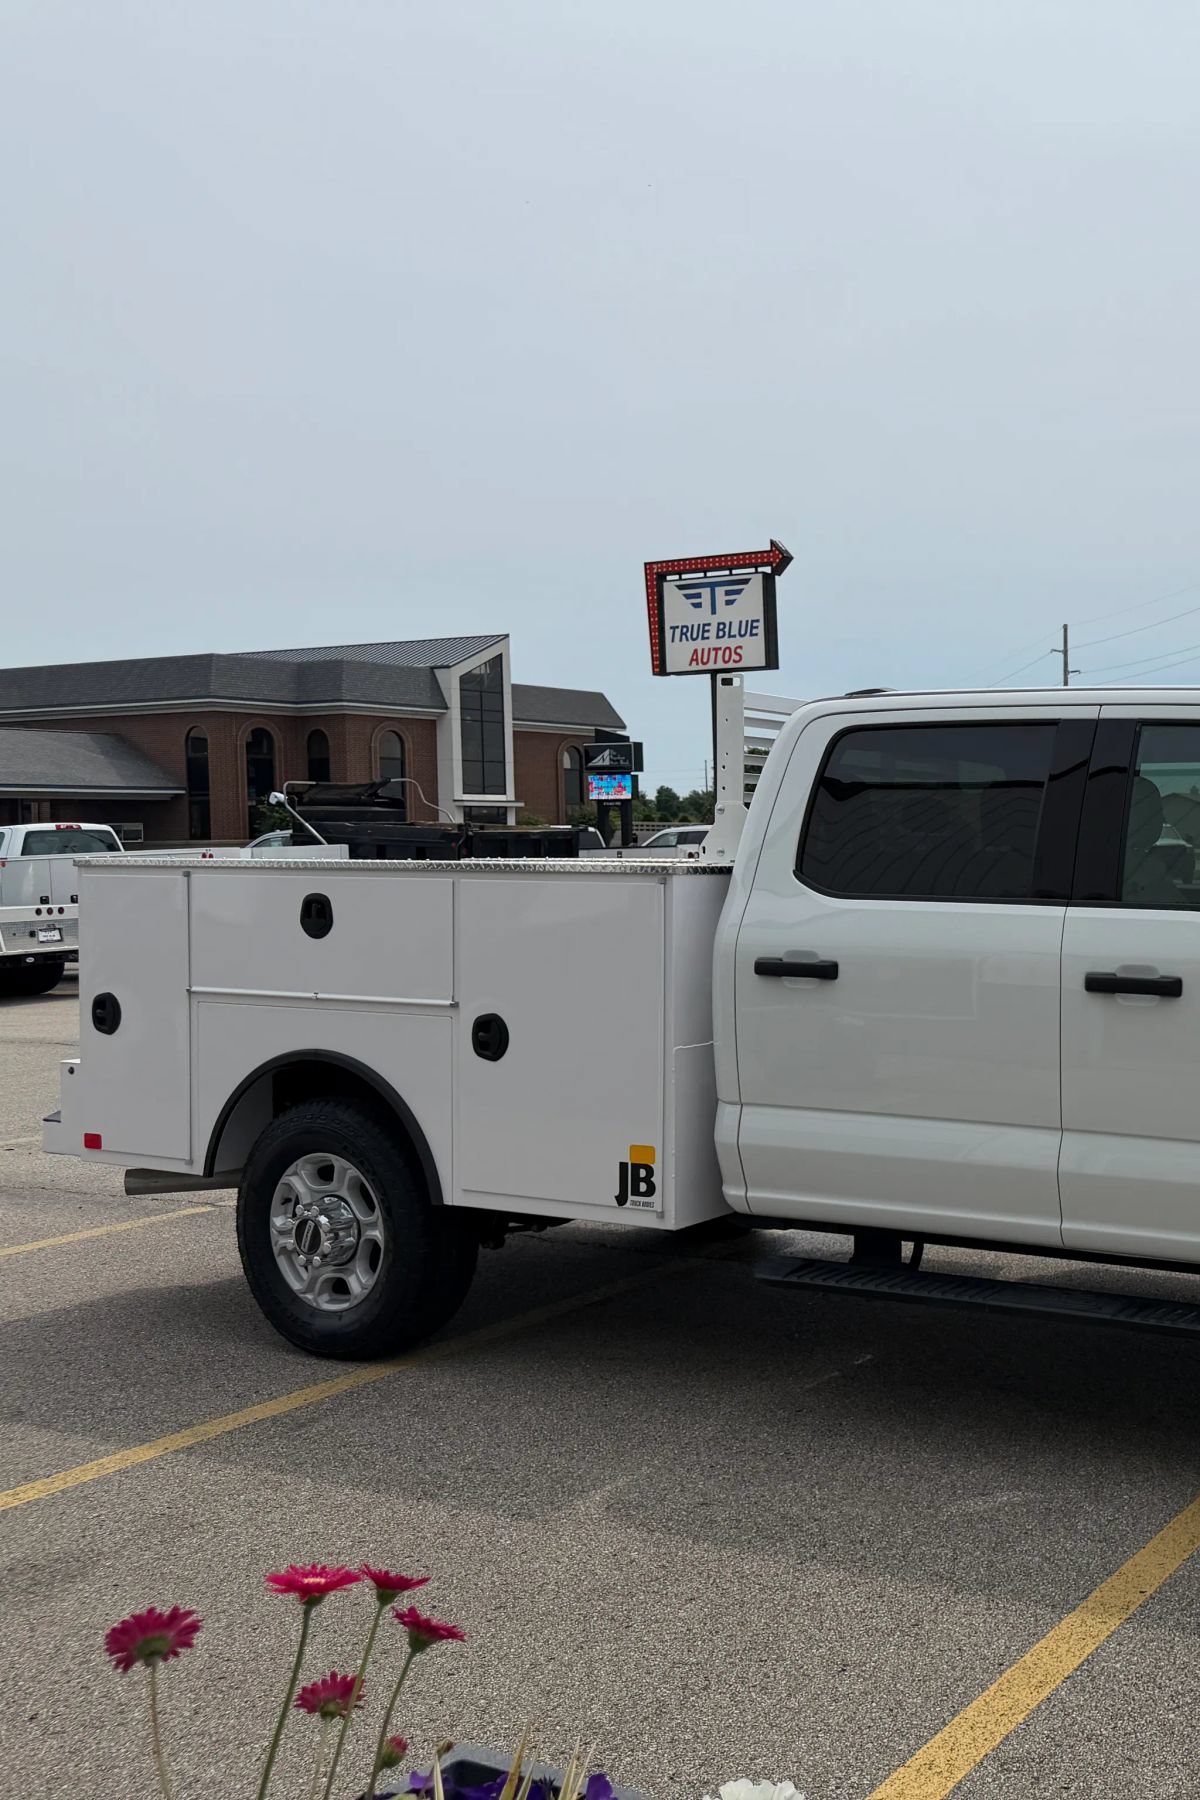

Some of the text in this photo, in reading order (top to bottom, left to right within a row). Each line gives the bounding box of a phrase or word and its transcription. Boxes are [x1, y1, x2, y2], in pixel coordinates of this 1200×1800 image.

[670, 619, 760, 643] TRUE BLUE
[688, 645, 743, 666] AUTOS
[614, 1161, 656, 1207] JB
